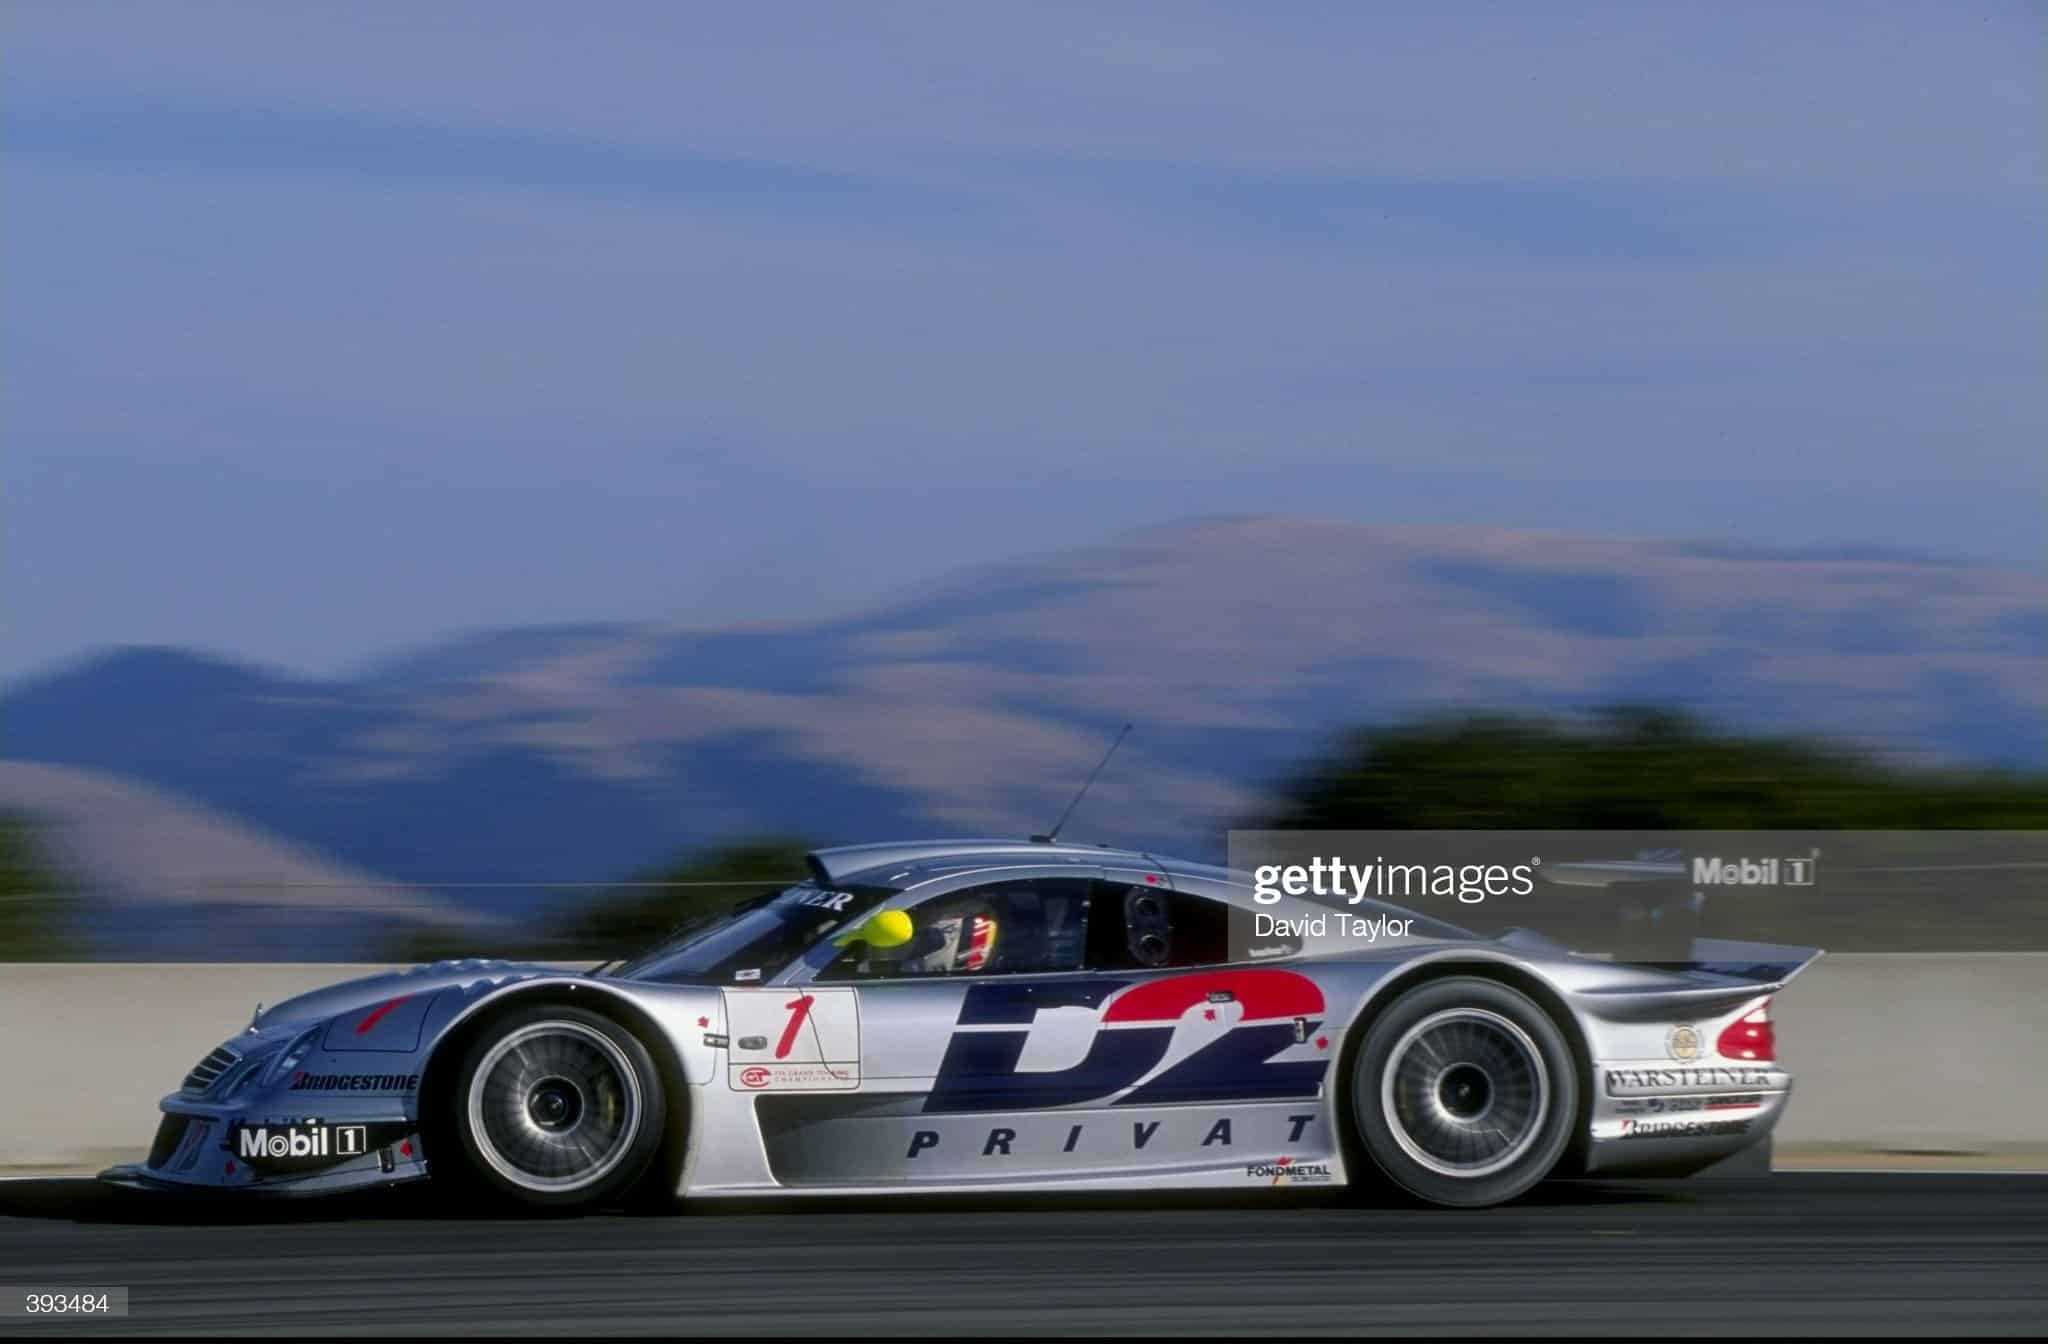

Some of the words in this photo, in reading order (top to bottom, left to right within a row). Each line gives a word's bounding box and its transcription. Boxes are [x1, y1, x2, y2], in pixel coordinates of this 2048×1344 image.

[1693, 857, 1778, 884] Mobil
[775, 995, 815, 1059] 1
[921, 969, 1330, 1113] D2
[291, 1072, 419, 1090] BRIDGESTONE
[1608, 1069, 1772, 1088] WARSTEINER
[240, 1127, 328, 1157] Mobil
[1246, 1165, 1331, 1177] FONDMETAL
